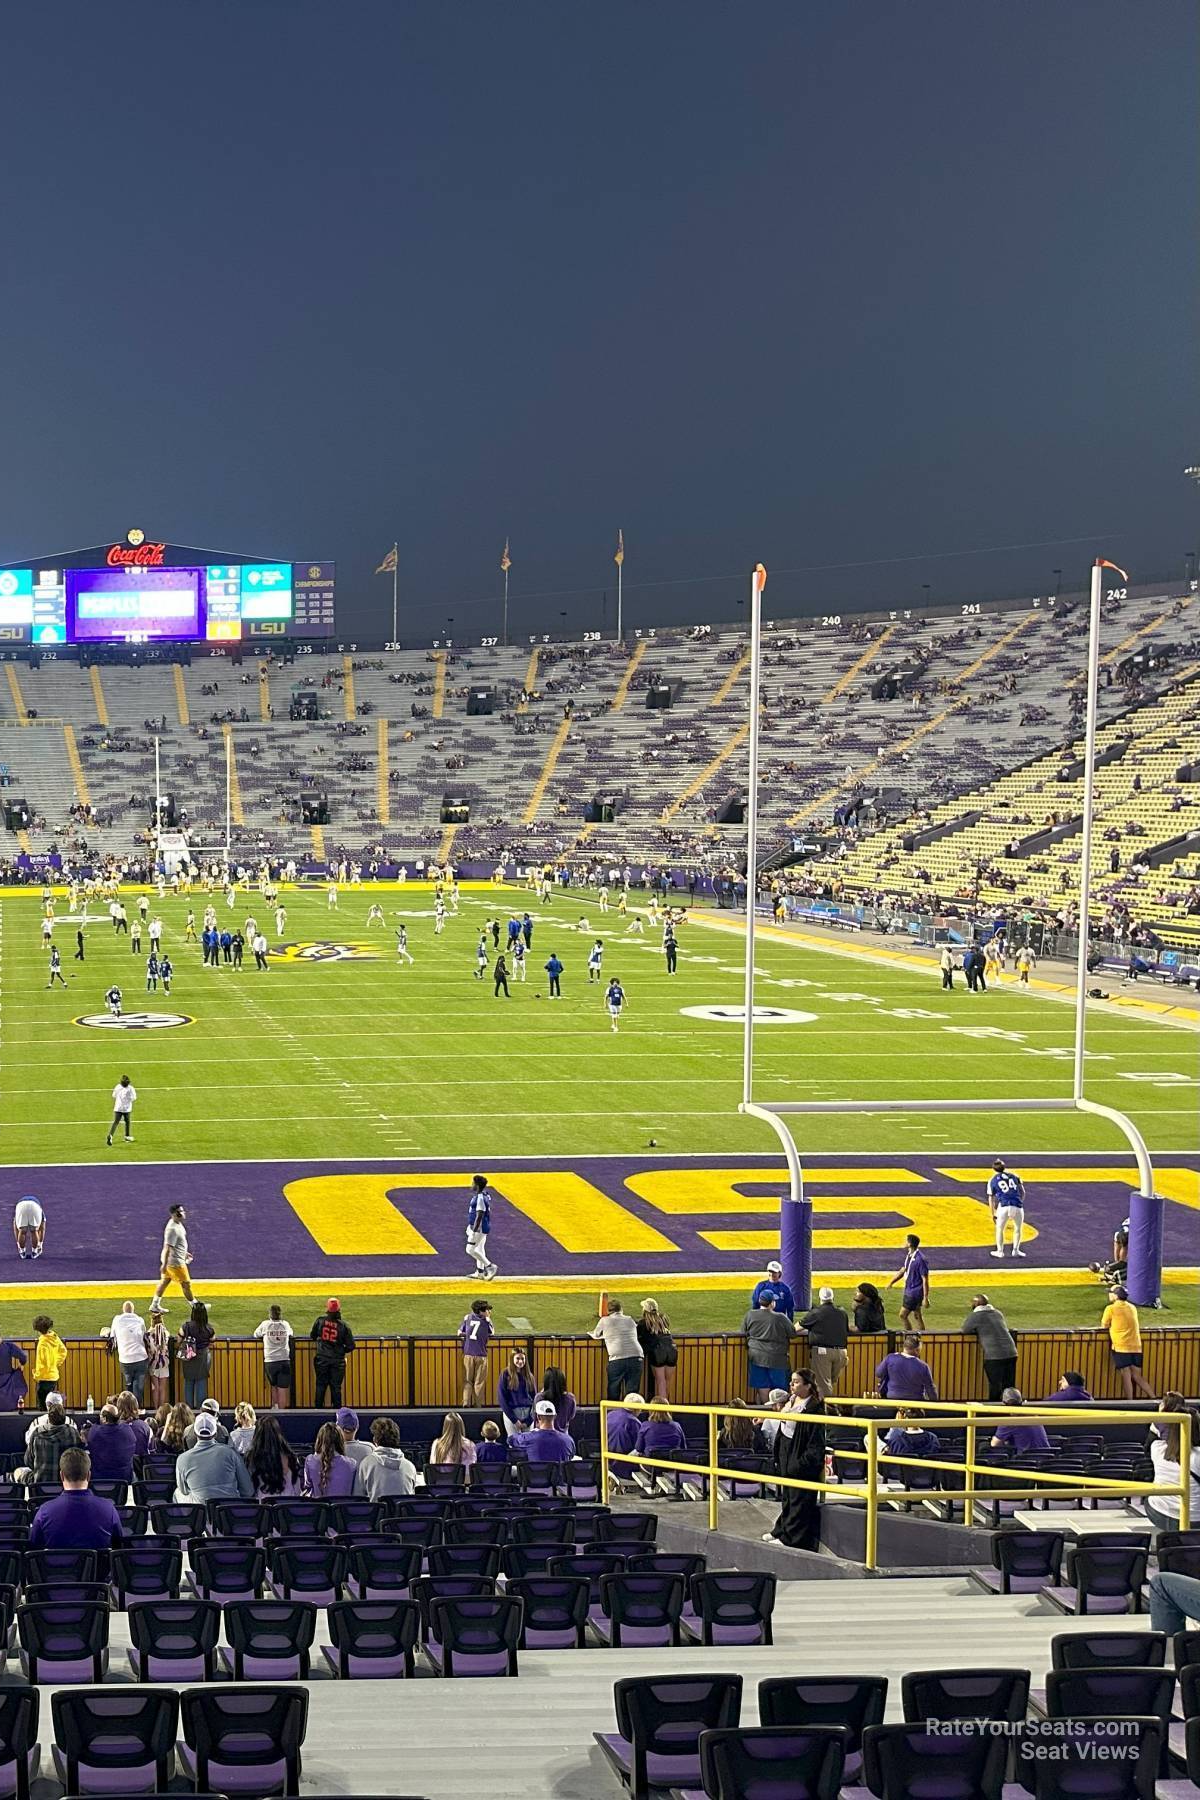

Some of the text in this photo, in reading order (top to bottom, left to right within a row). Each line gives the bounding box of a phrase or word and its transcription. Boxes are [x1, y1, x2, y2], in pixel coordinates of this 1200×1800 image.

[107, 544, 165, 566] Coca-Cola
[1106, 588, 1127, 600] 242
[961, 603, 981, 615] 241
[822, 616, 841, 626] 240
[250, 622, 286, 635] LSU
[693, 625, 711, 635] 239
[583, 632, 601, 641] 238
[384, 642, 401, 651] 236
[481, 637, 498, 647] 237
[210, 648, 226, 657] 234
[296, 645, 313, 654] 235
[41, 652, 57, 660] 232
[997, 1178, 1018, 1193] 94
[321, 1327, 338, 1342] 62
[469, 1320, 481, 1340] 7
